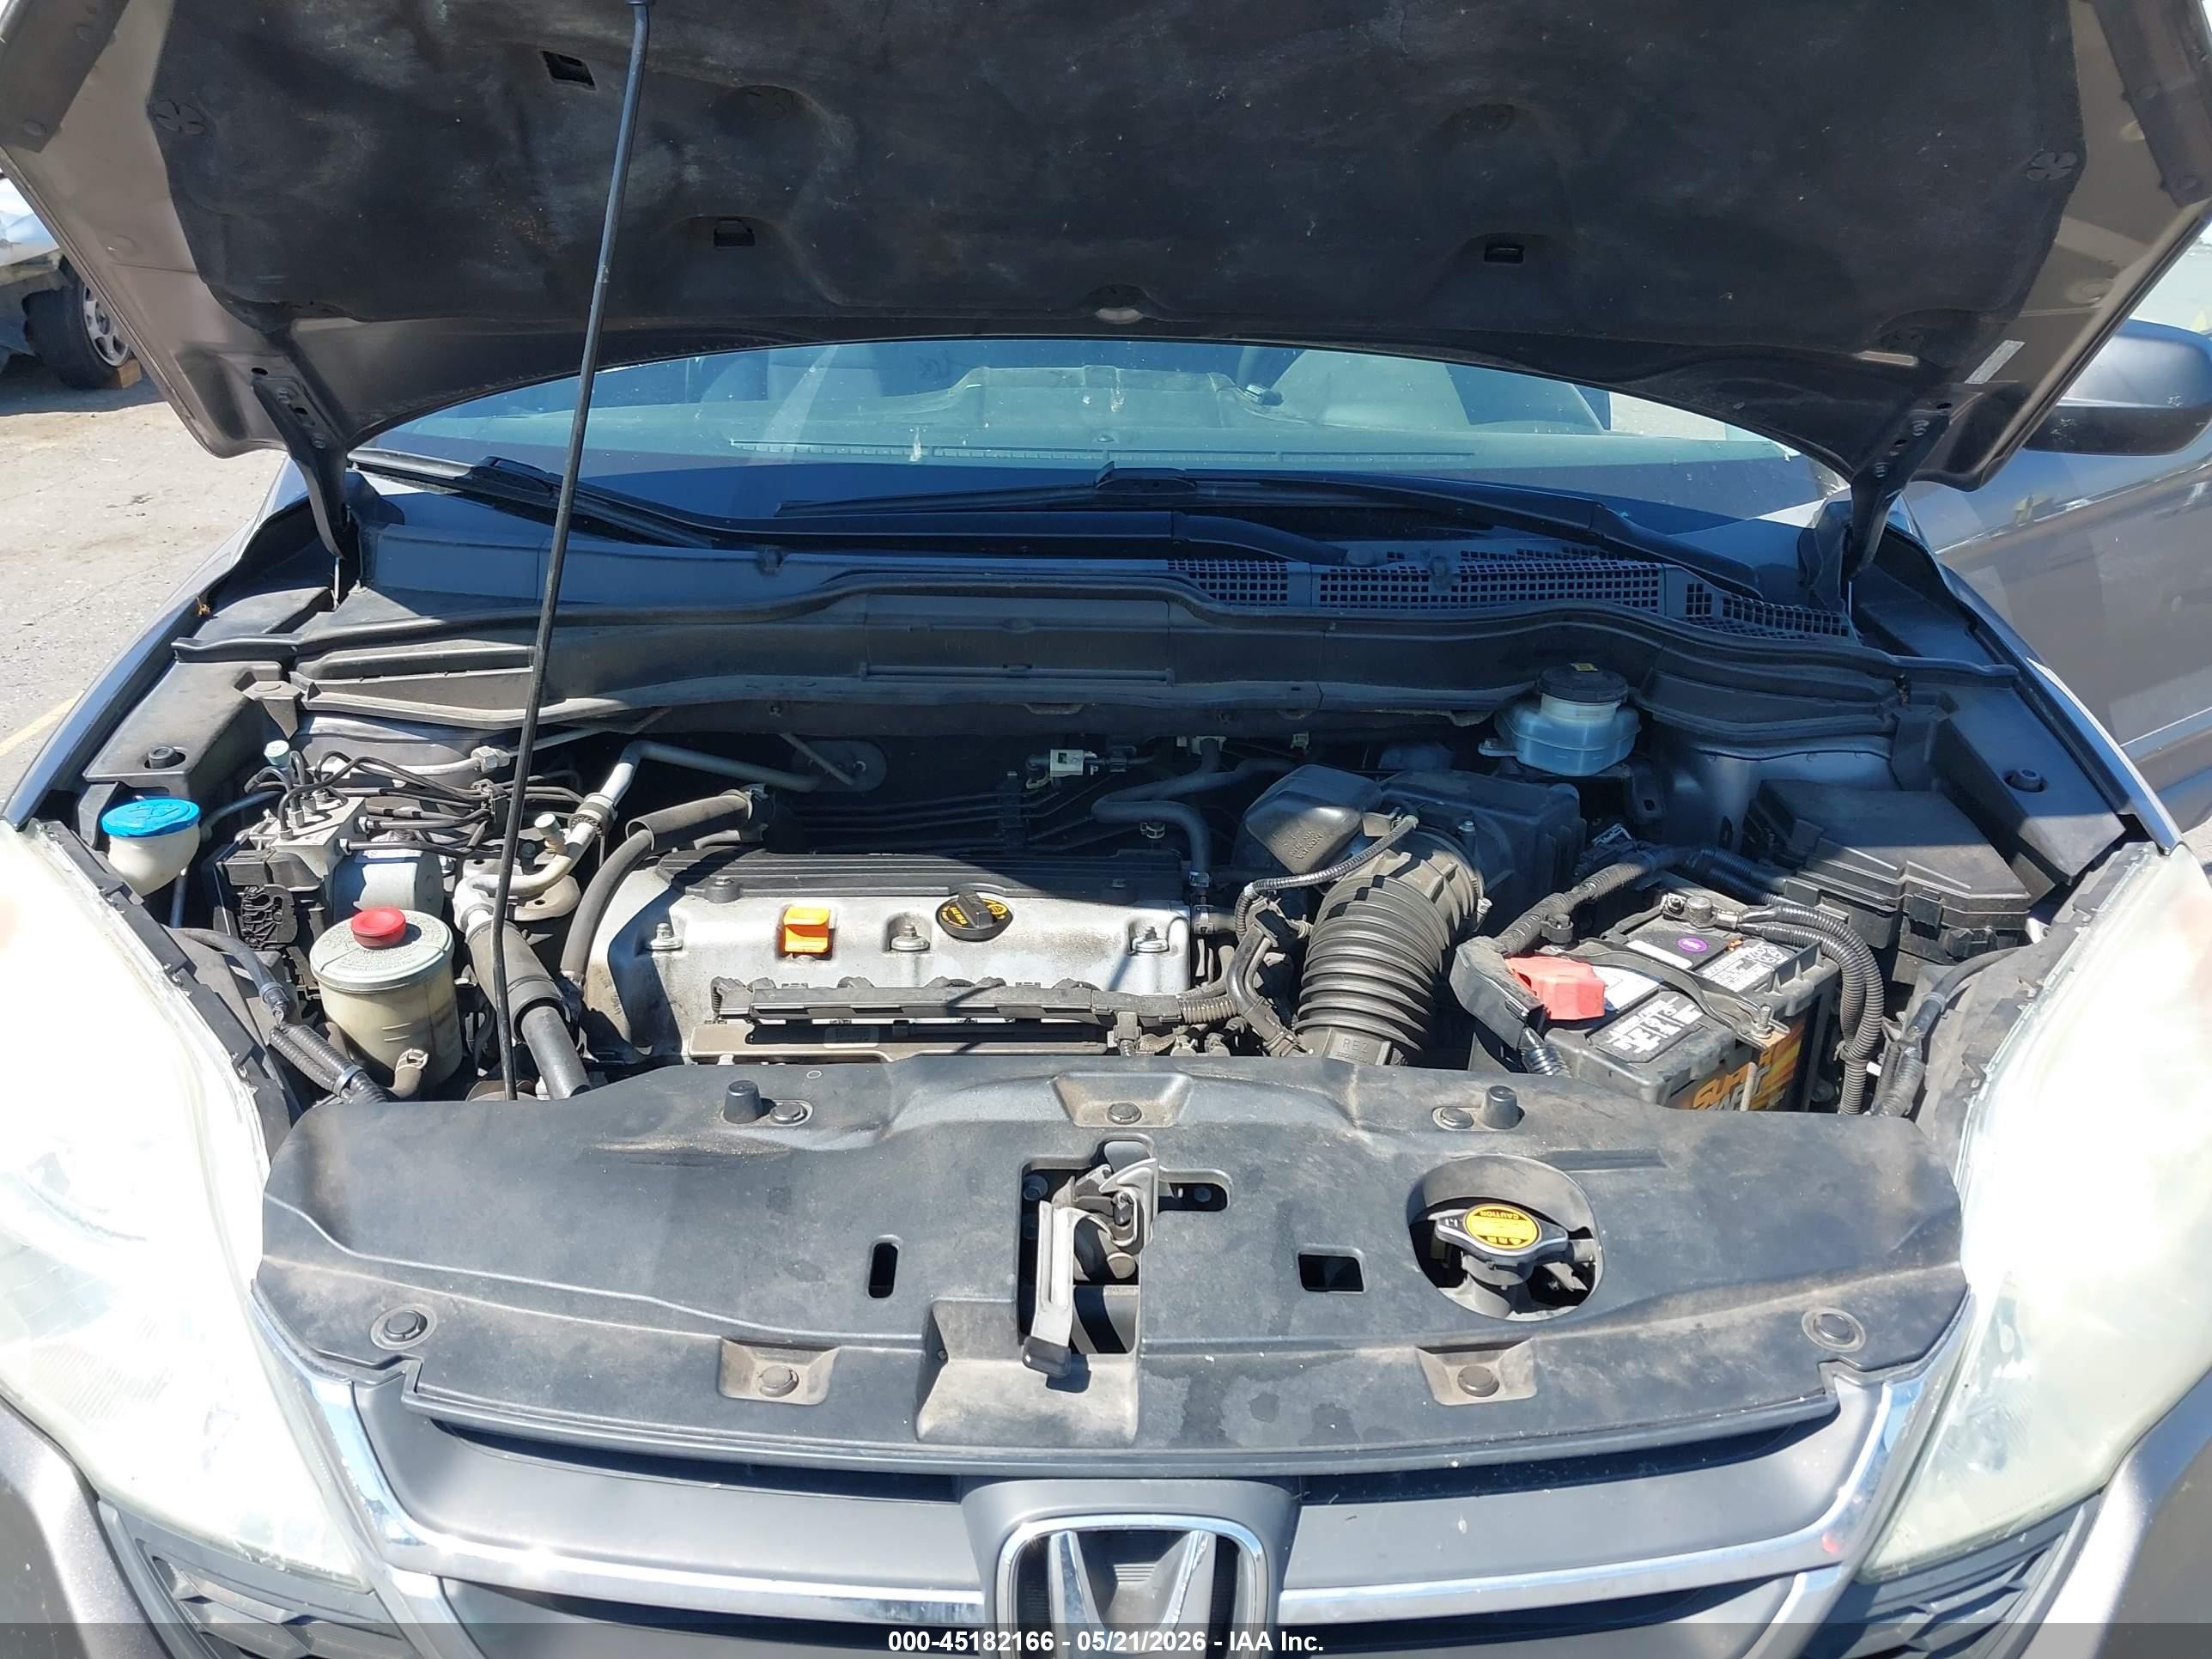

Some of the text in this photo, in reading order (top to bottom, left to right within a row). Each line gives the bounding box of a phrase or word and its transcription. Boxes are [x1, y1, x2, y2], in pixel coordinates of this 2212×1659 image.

[1343, 1038, 1369, 1053] REZ
[1692, 1044, 1773, 1110] SUPR
[1480, 1210, 1520, 1220] CAUTION
